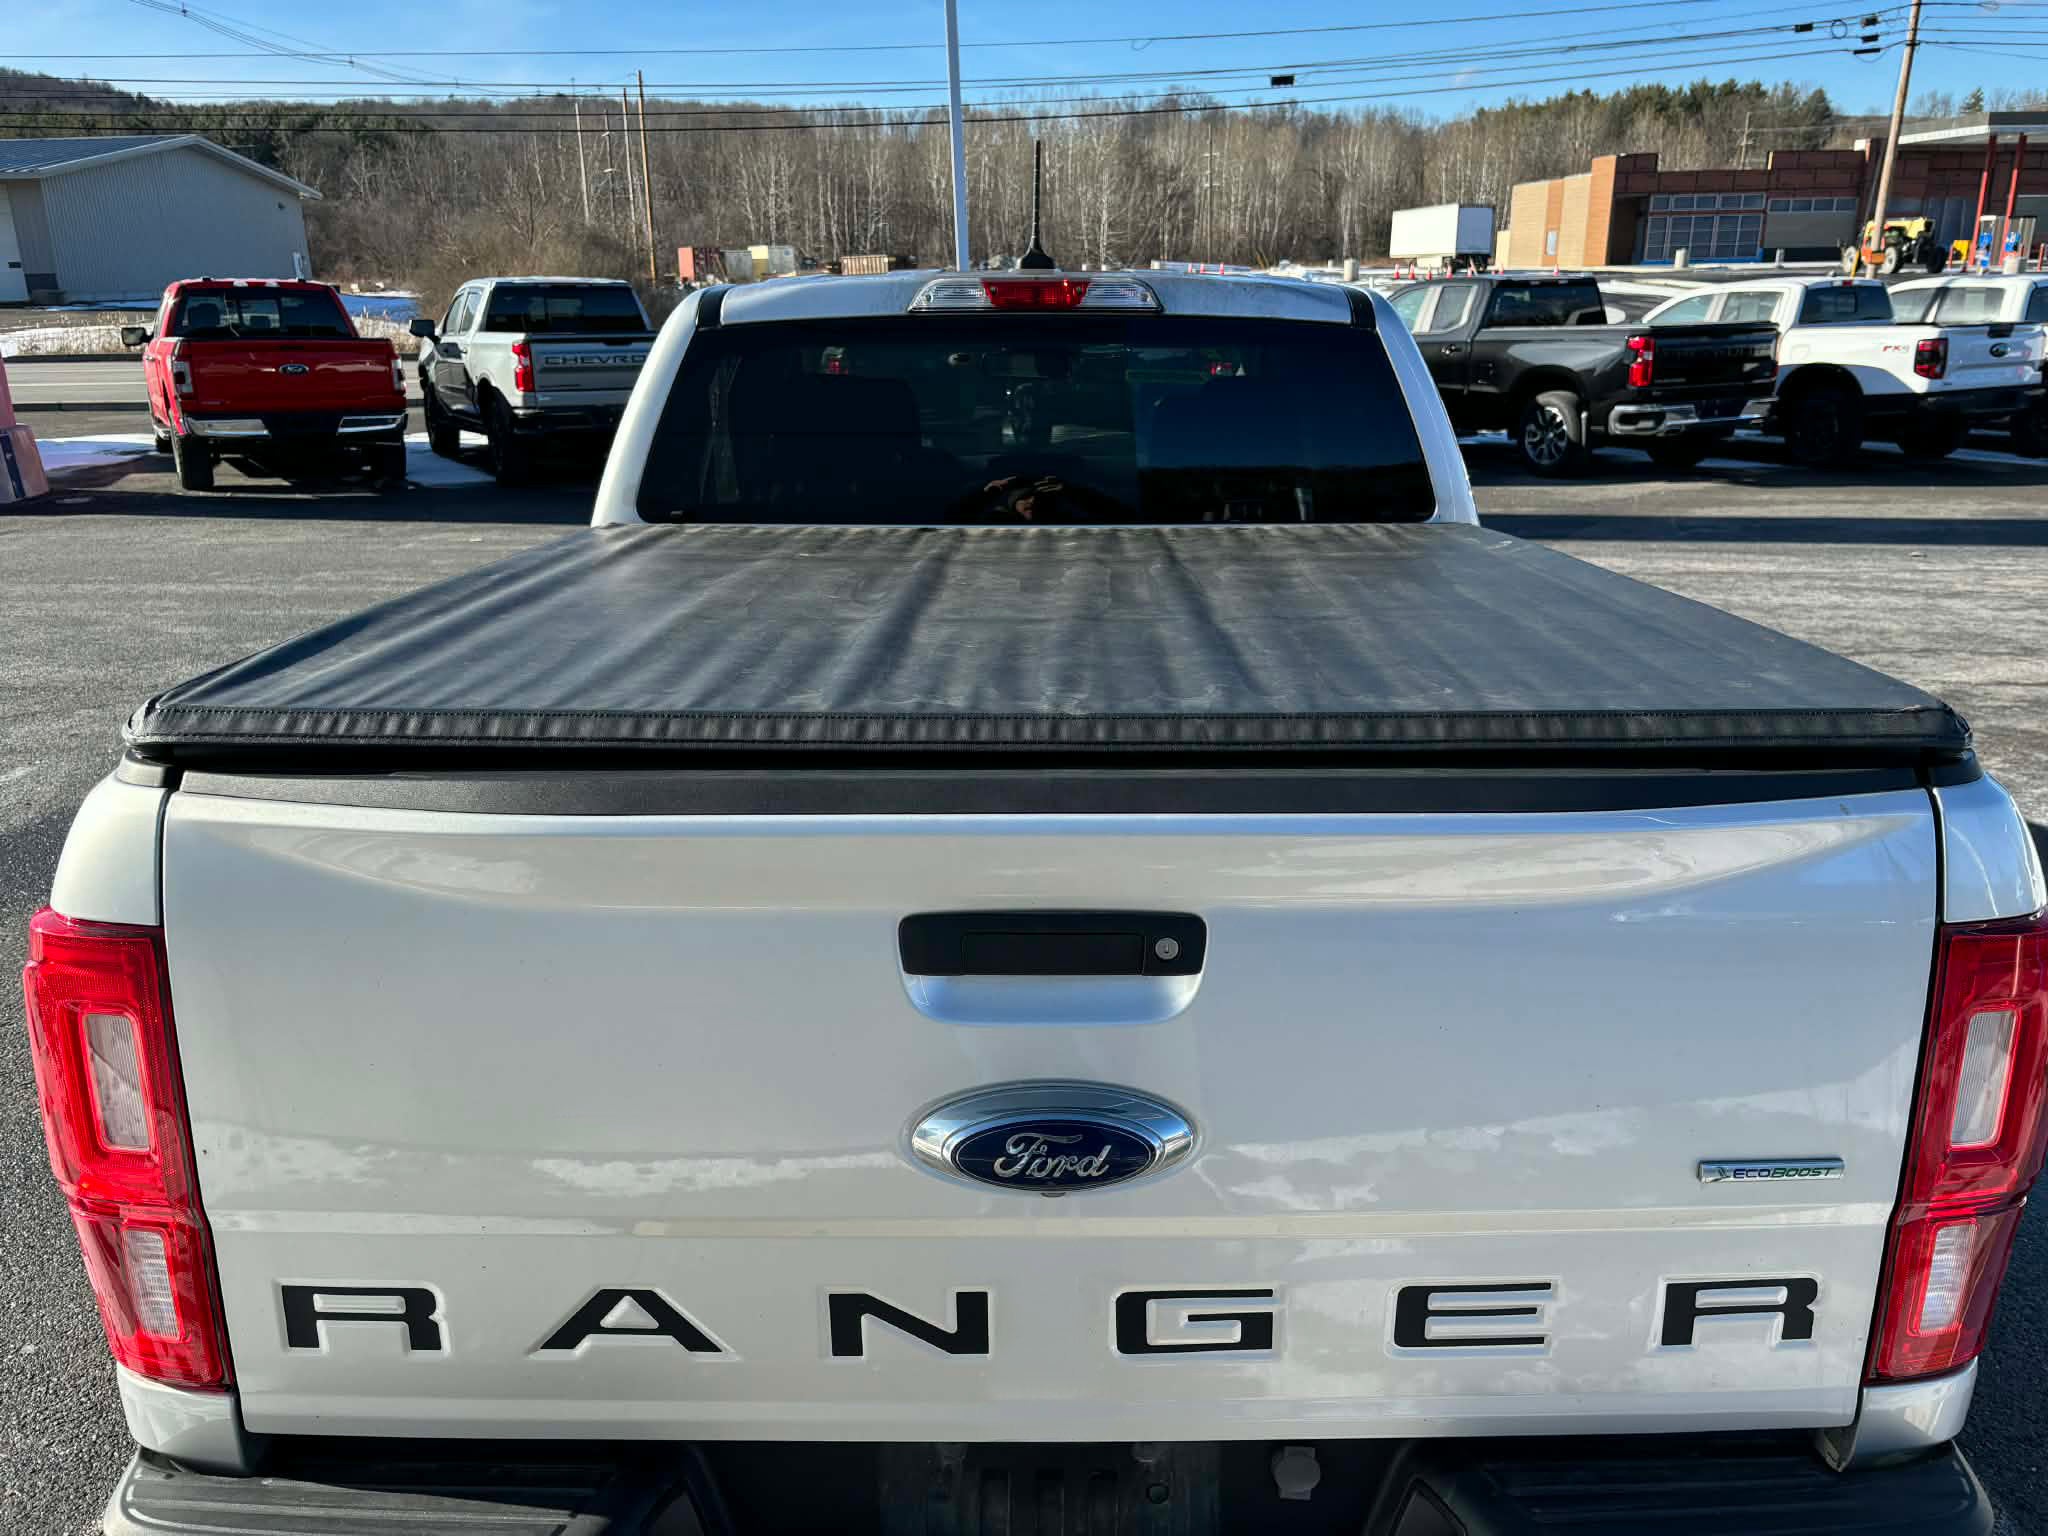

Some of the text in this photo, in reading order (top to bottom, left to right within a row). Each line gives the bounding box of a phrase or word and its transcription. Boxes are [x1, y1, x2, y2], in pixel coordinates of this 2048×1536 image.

[993, 1132, 1112, 1178] Ford
[1732, 1166, 1836, 1179] ECOBOOST
[279, 1277, 1819, 1357] RANGER
